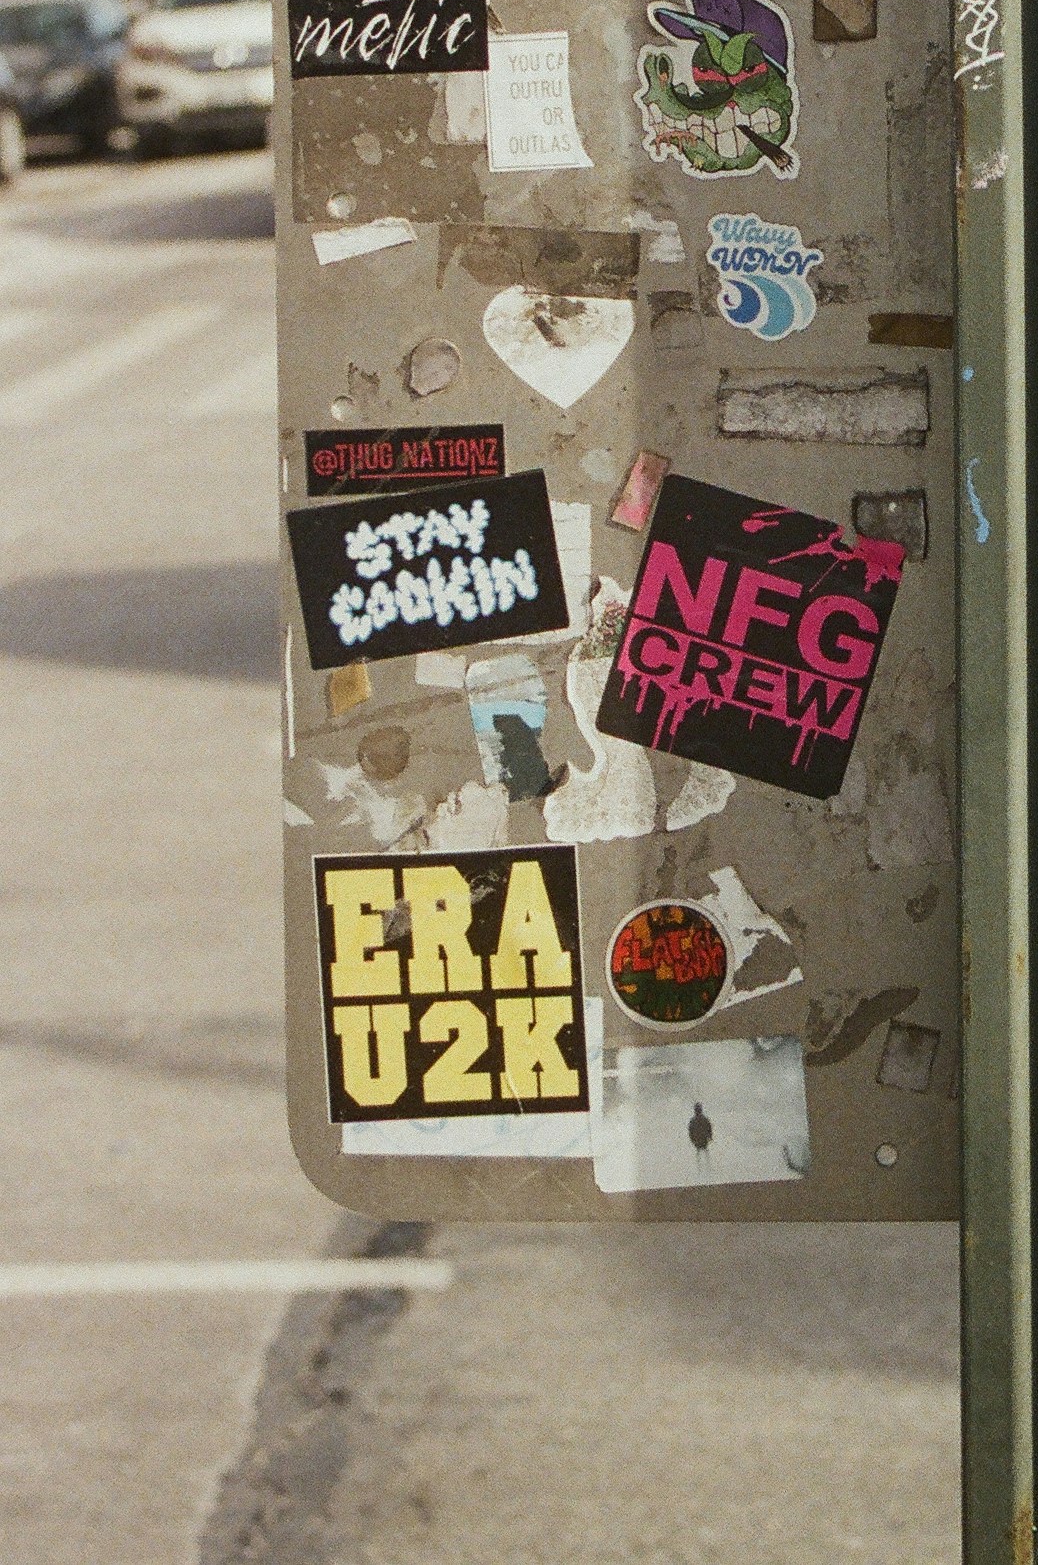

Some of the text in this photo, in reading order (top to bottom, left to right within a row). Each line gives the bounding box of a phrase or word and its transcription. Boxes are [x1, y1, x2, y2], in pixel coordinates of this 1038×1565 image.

[509, 53, 540, 72] YOU
[312, 440, 394, 479] @THUG
[344, 498, 492, 580] STAY
[328, 548, 539, 647] COOKIN
[632, 540, 880, 679] NFG
[628, 626, 856, 731] CREW
[324, 860, 573, 998] ERA
[332, 995, 581, 1108] U2K
